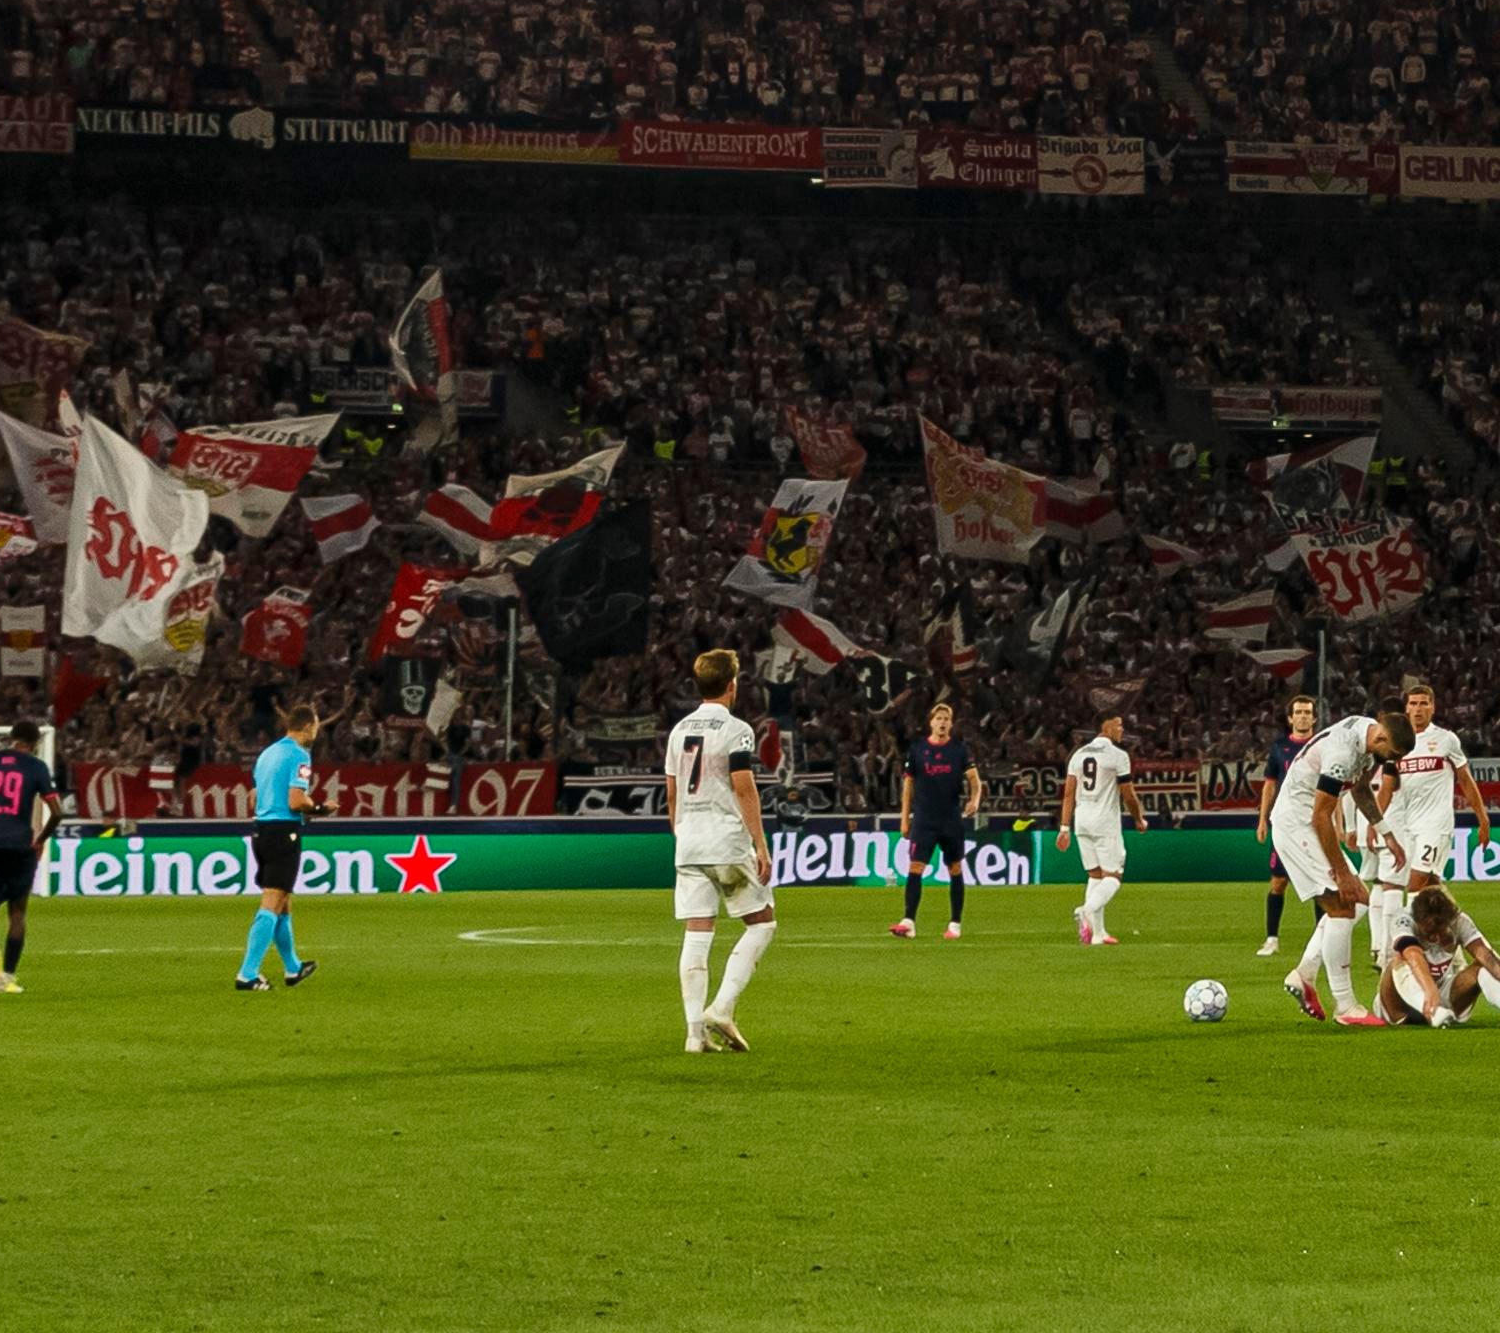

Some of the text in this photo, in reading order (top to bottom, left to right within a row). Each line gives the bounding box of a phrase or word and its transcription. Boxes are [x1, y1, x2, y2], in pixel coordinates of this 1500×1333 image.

[283, 114, 409, 144] STUTTGART
[631, 125, 809, 160] SCHWABENFRONT
[683, 735, 705, 795] 7
[1083, 756, 1098, 792] 9
[467, 767, 547, 816] 97
[36, 838, 379, 895] Heineen
[771, 831, 1032, 886] Heinken
[1421, 844, 1438, 863] 21
